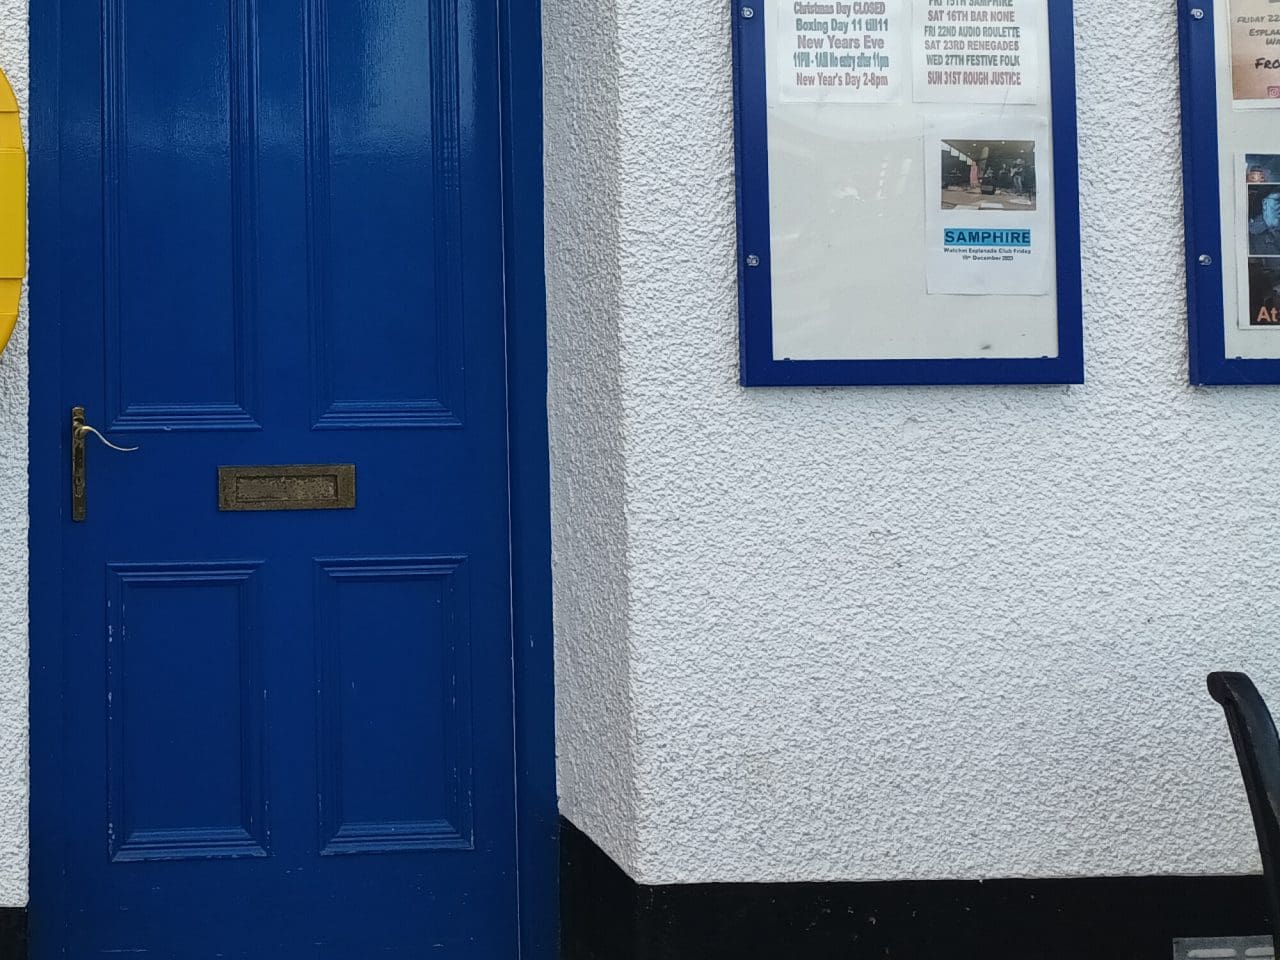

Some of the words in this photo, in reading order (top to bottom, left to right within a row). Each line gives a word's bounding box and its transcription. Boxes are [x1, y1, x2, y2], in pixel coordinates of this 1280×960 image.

[793, 1, 835, 15] Christmas
[836, 1, 851, 18] Day
[853, 1, 886, 15] CLOSED
[927, 10, 944, 21] SAT
[946, 10, 968, 22] 16TH
[970, 10, 988, 22] BAR
[990, 11, 1015, 22] NONE
[795, 18, 829, 35] Boxing
[831, 18, 849, 34] Day
[851, 18, 862, 32] 11
[924, 25, 936, 37] FRI
[937, 25, 957, 37] 22ND
[958, 26, 981, 37] AUDIO
[982, 26, 1021, 38] ROULETTE
[797, 34, 824, 49] New
[827, 34, 861, 49] Years
[863, 34, 885, 49] Eve
[924, 40, 941, 50] SAT
[943, 40, 965, 50] 23RD
[967, 40, 1020, 51] RENEGADES
[926, 54, 943, 66] WED
[944, 54, 965, 66] 27TH
[966, 54, 998, 66] FESTIVE
[1000, 55, 1020, 67] FOLK
[796, 72, 815, 86] New
[817, 72, 843, 86] Year's
[845, 72, 861, 90] Day
[927, 70, 943, 85] SUN
[944, 70, 962, 86] 31ST
[962, 71, 989, 86] ROUGH
[990, 71, 1021, 86] JUSTICE
[944, 230, 1031, 244] SAMPHIRE
